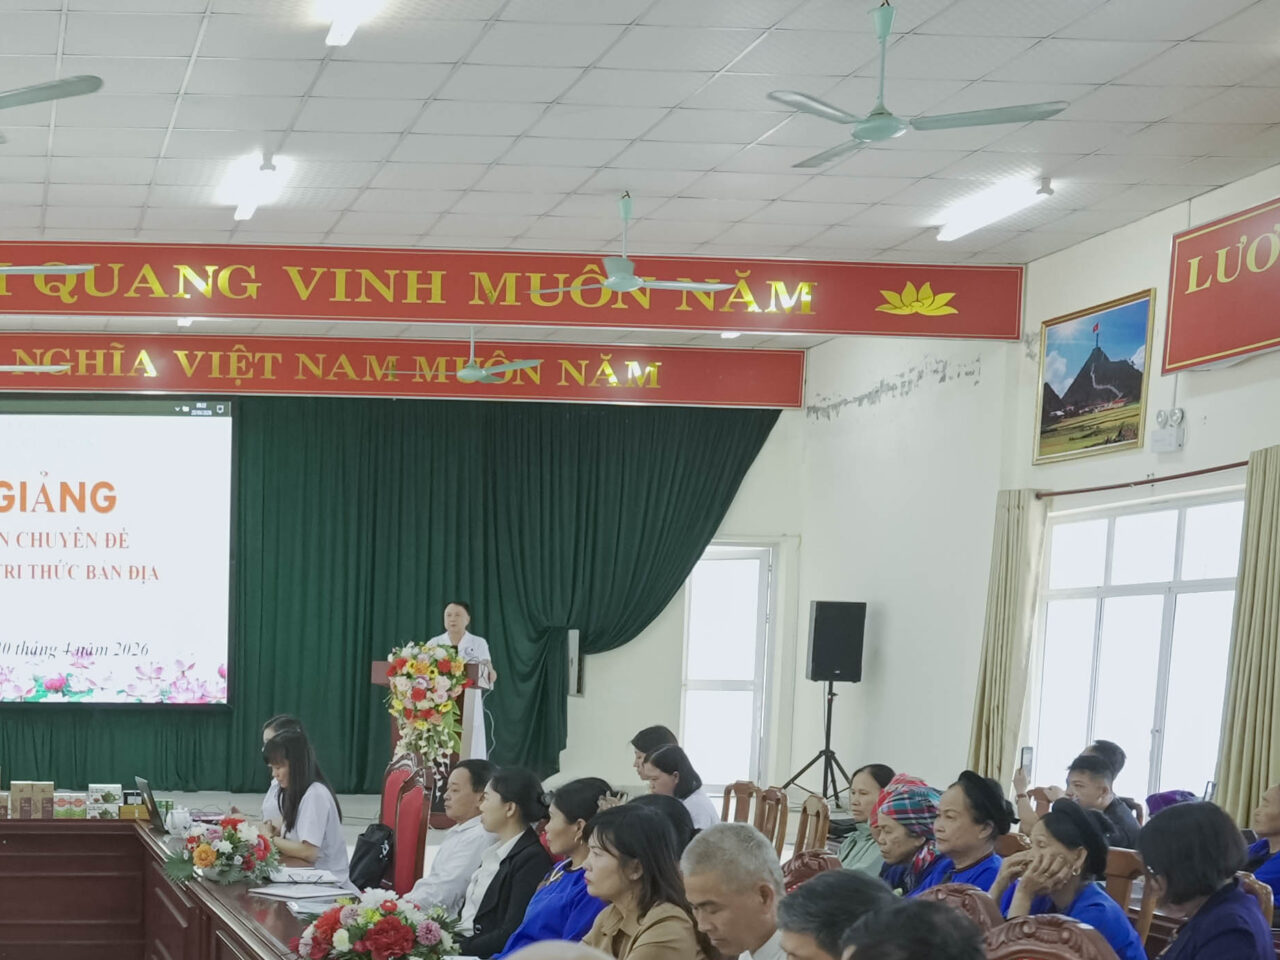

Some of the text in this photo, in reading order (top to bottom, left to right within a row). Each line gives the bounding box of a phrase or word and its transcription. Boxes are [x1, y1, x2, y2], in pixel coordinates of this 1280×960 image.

[33, 261, 262, 304] QUANG
[282, 266, 446, 304] VINH
[468, 264, 656, 309] MUÔN
[675, 269, 818, 315] NĂM
[12, 342, 158, 378] NGHĨA
[174, 344, 282, 386] VIỆT
[295, 353, 400, 383] NAM
[557, 352, 662, 388] NĂM
[16, 526, 98, 549] CHUYÊN
[128, 564, 160, 584] ĐỊA
[113, 642, 149, 656] 2026
